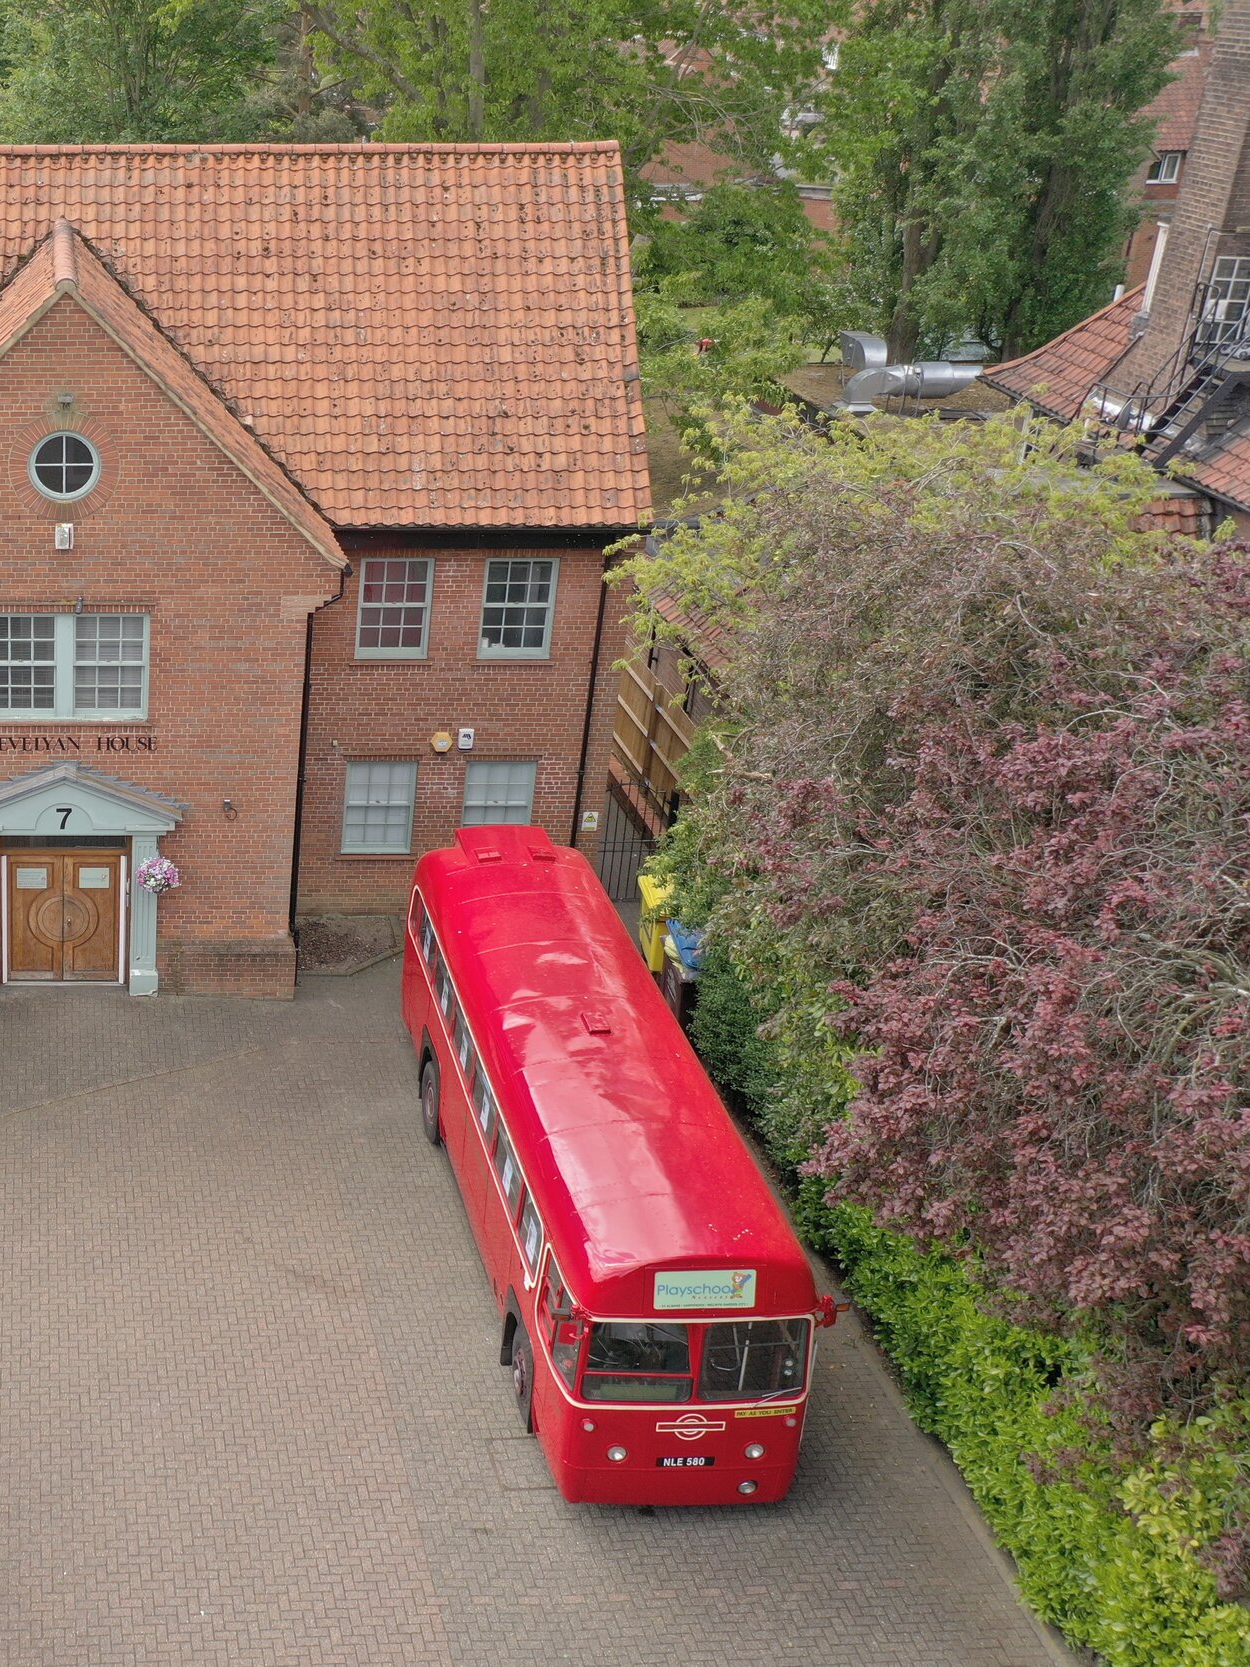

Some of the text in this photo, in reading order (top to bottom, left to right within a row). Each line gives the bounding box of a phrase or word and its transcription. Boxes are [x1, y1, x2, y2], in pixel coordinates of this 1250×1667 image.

[97, 736, 158, 751] HOUSE
[56, 808, 72, 830] 7
[663, 1457, 705, 1466] NLE 580
